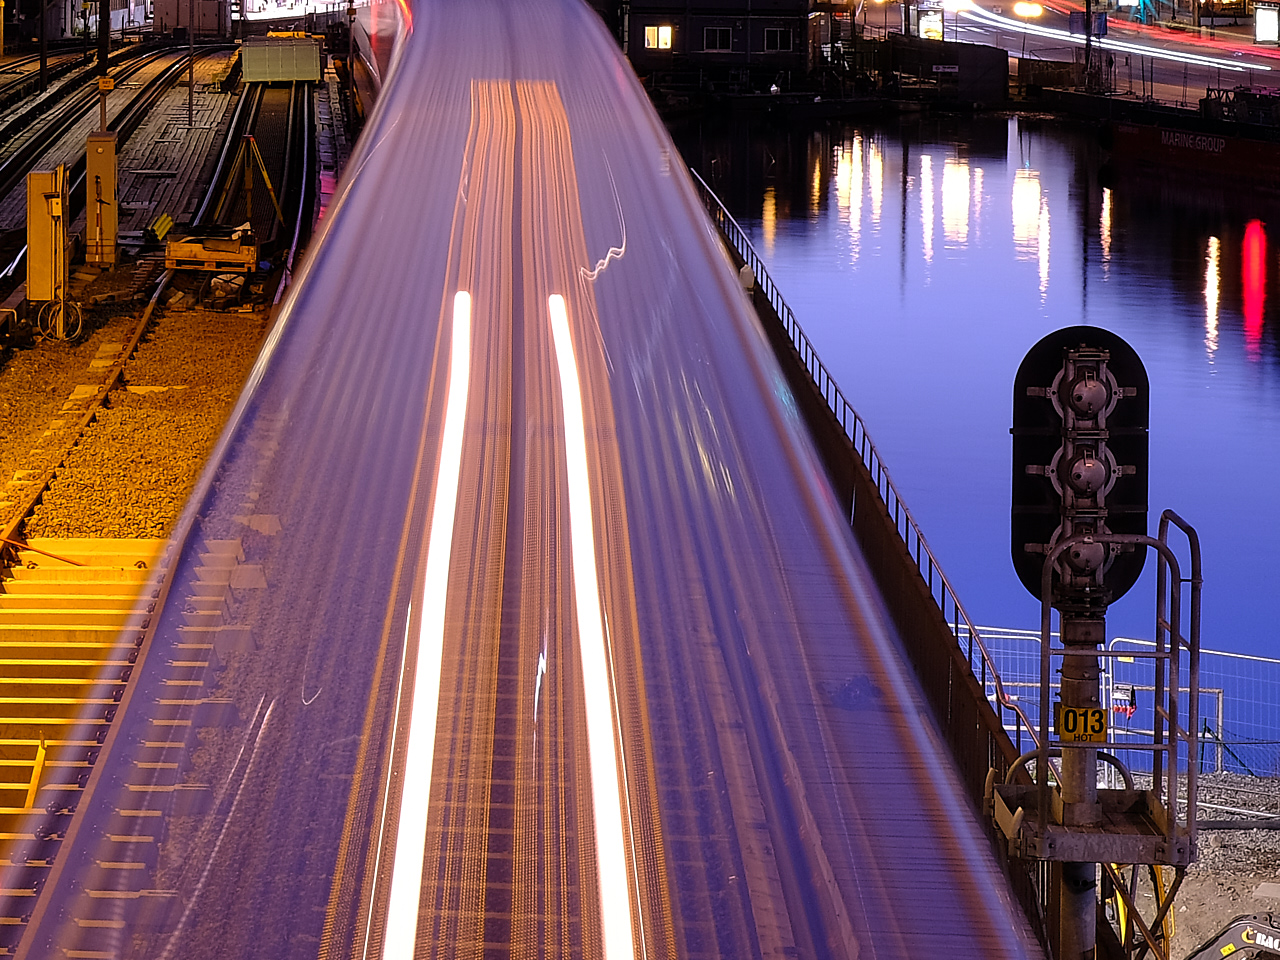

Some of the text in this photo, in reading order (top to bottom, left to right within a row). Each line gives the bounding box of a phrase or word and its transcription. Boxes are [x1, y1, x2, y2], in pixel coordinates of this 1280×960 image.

[1161, 130, 1226, 153] MARINE GROUP
[1064, 709, 1104, 734] 013
[1073, 733, 1094, 742] HOT
